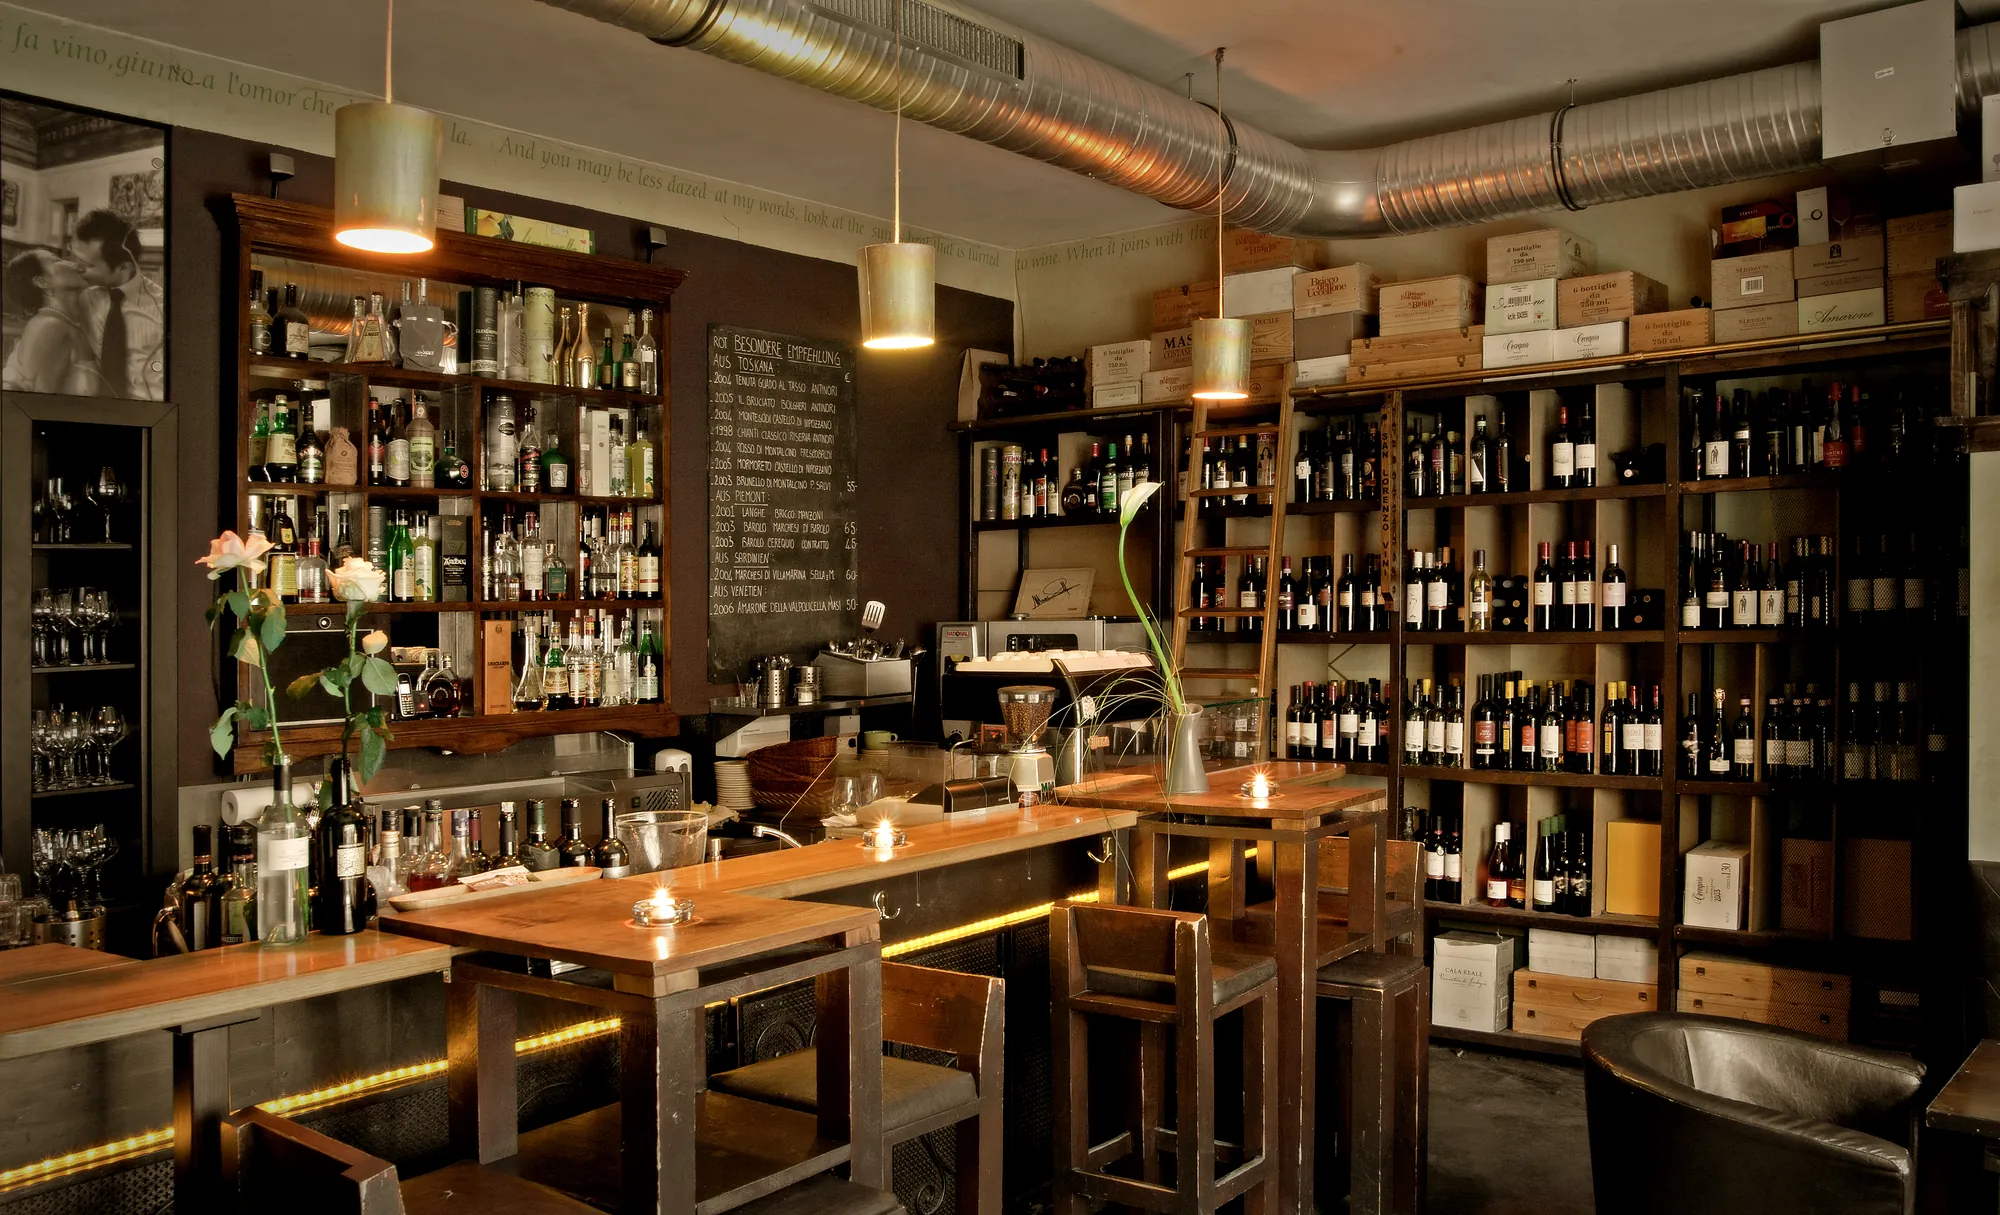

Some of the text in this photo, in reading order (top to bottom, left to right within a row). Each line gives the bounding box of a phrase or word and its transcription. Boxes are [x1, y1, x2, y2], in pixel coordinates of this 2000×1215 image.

[202, 74, 214, 90] a
[228, 71, 297, 106] l'omor
[302, 91, 334, 116] che
[499, 136, 535, 161] And
[541, 151, 570, 169] you
[577, 157, 612, 183] may
[618, 160, 633, 182] be
[639, 167, 663, 189] less
[667, 175, 707, 200] dazed
[714, 188, 728, 204] at
[733, 192, 754, 214] my
[759, 200, 798, 222] words,
[803, 205, 829, 228] look
[832, 215, 843, 230] at
[848, 216, 865, 236] the
[932, 237, 953, 256] that
[956, 246, 965, 259] is
[968, 246, 999, 268] turned
[1016, 257, 1028, 271] to
[1032, 252, 1061, 269] wine.
[1066, 244, 1103, 262] When
[1107, 240, 1116, 255] it
[1119, 237, 1150, 258] joins
[1155, 227, 1183, 248] with
[1190, 223, 1209, 241] the
[1513, 244, 1541, 252] bottiglie
[1311, 276, 1338, 286] Bricco
[1581, 282, 1617, 292] bottiglie
[1307, 283, 1346, 298] Uccellone
[1597, 298, 1610, 306] ml.
[1808, 305, 1874, 325] Amarone
[1653, 319, 1691, 329] bottiglie
[1163, 334, 1192, 349] MAS
[714, 334, 840, 366] ROT BESONDERE EMPFEHLUNG
[1163, 348, 1192, 360] COSTASE
[713, 354, 731, 369] AUS
[845, 373, 850, 382] €
[735, 374, 756, 384] TENUTA
[758, 378, 777, 390] GUADO
[779, 382, 786, 390] AL
[788, 381, 806, 392] TASSO
[811, 383, 837, 396] ANTINORI
[739, 395, 744, 405] IL
[747, 395, 775, 408] BRUCIATO
[811, 404, 836, 414] ANTINORI
[773, 414, 795, 425] CASTELLO
[797, 417, 802, 426] DI
[737, 428, 759, 438] CHIANTI
[761, 431, 787, 441] CLASSICO
[790, 432, 811, 442] RISERVA
[813, 434, 834, 444] ANTINORI
[737, 442, 755, 454] ROSSO
[757, 444, 762, 454] DI
[765, 445, 796, 457] MONTALCINO
[1381, 432, 1389, 459] SAN
[737, 459, 771, 471] MORMORETO
[775, 462, 797, 473] CASTELLO
[799, 464, 803, 473] DI
[737, 475, 764, 487] BRUNELLO
[767, 479, 773, 488] DI
[773, 479, 807, 489] MONTALCINO
[716, 490, 731, 501] AUS
[1381, 469, 1389, 532] LORENZO
[742, 507, 765, 518] LANGHE
[775, 508, 795, 519] BRICCO
[744, 522, 766, 533] BAROLO
[773, 522, 799, 533] MARCHESI
[803, 523, 808, 533] DI
[811, 523, 829, 534] BAROLO
[742, 537, 764, 548] BAROLO
[767, 538, 794, 549] CEREQUIO
[801, 540, 829, 550] CONTRATTO
[715, 552, 729, 564] AUS
[735, 570, 763, 580] MARCHESI
[765, 570, 770, 580] DI
[773, 570, 806, 580] VILLAMARINA
[714, 586, 728, 597] AUS
[737, 602, 767, 614] AMARONE
[770, 602, 788, 613] DELLA
[788, 601, 826, 612] VALPOLICELLA
[826, 598, 841, 612] MASI
[1445, 967, 1462, 975] CALA
